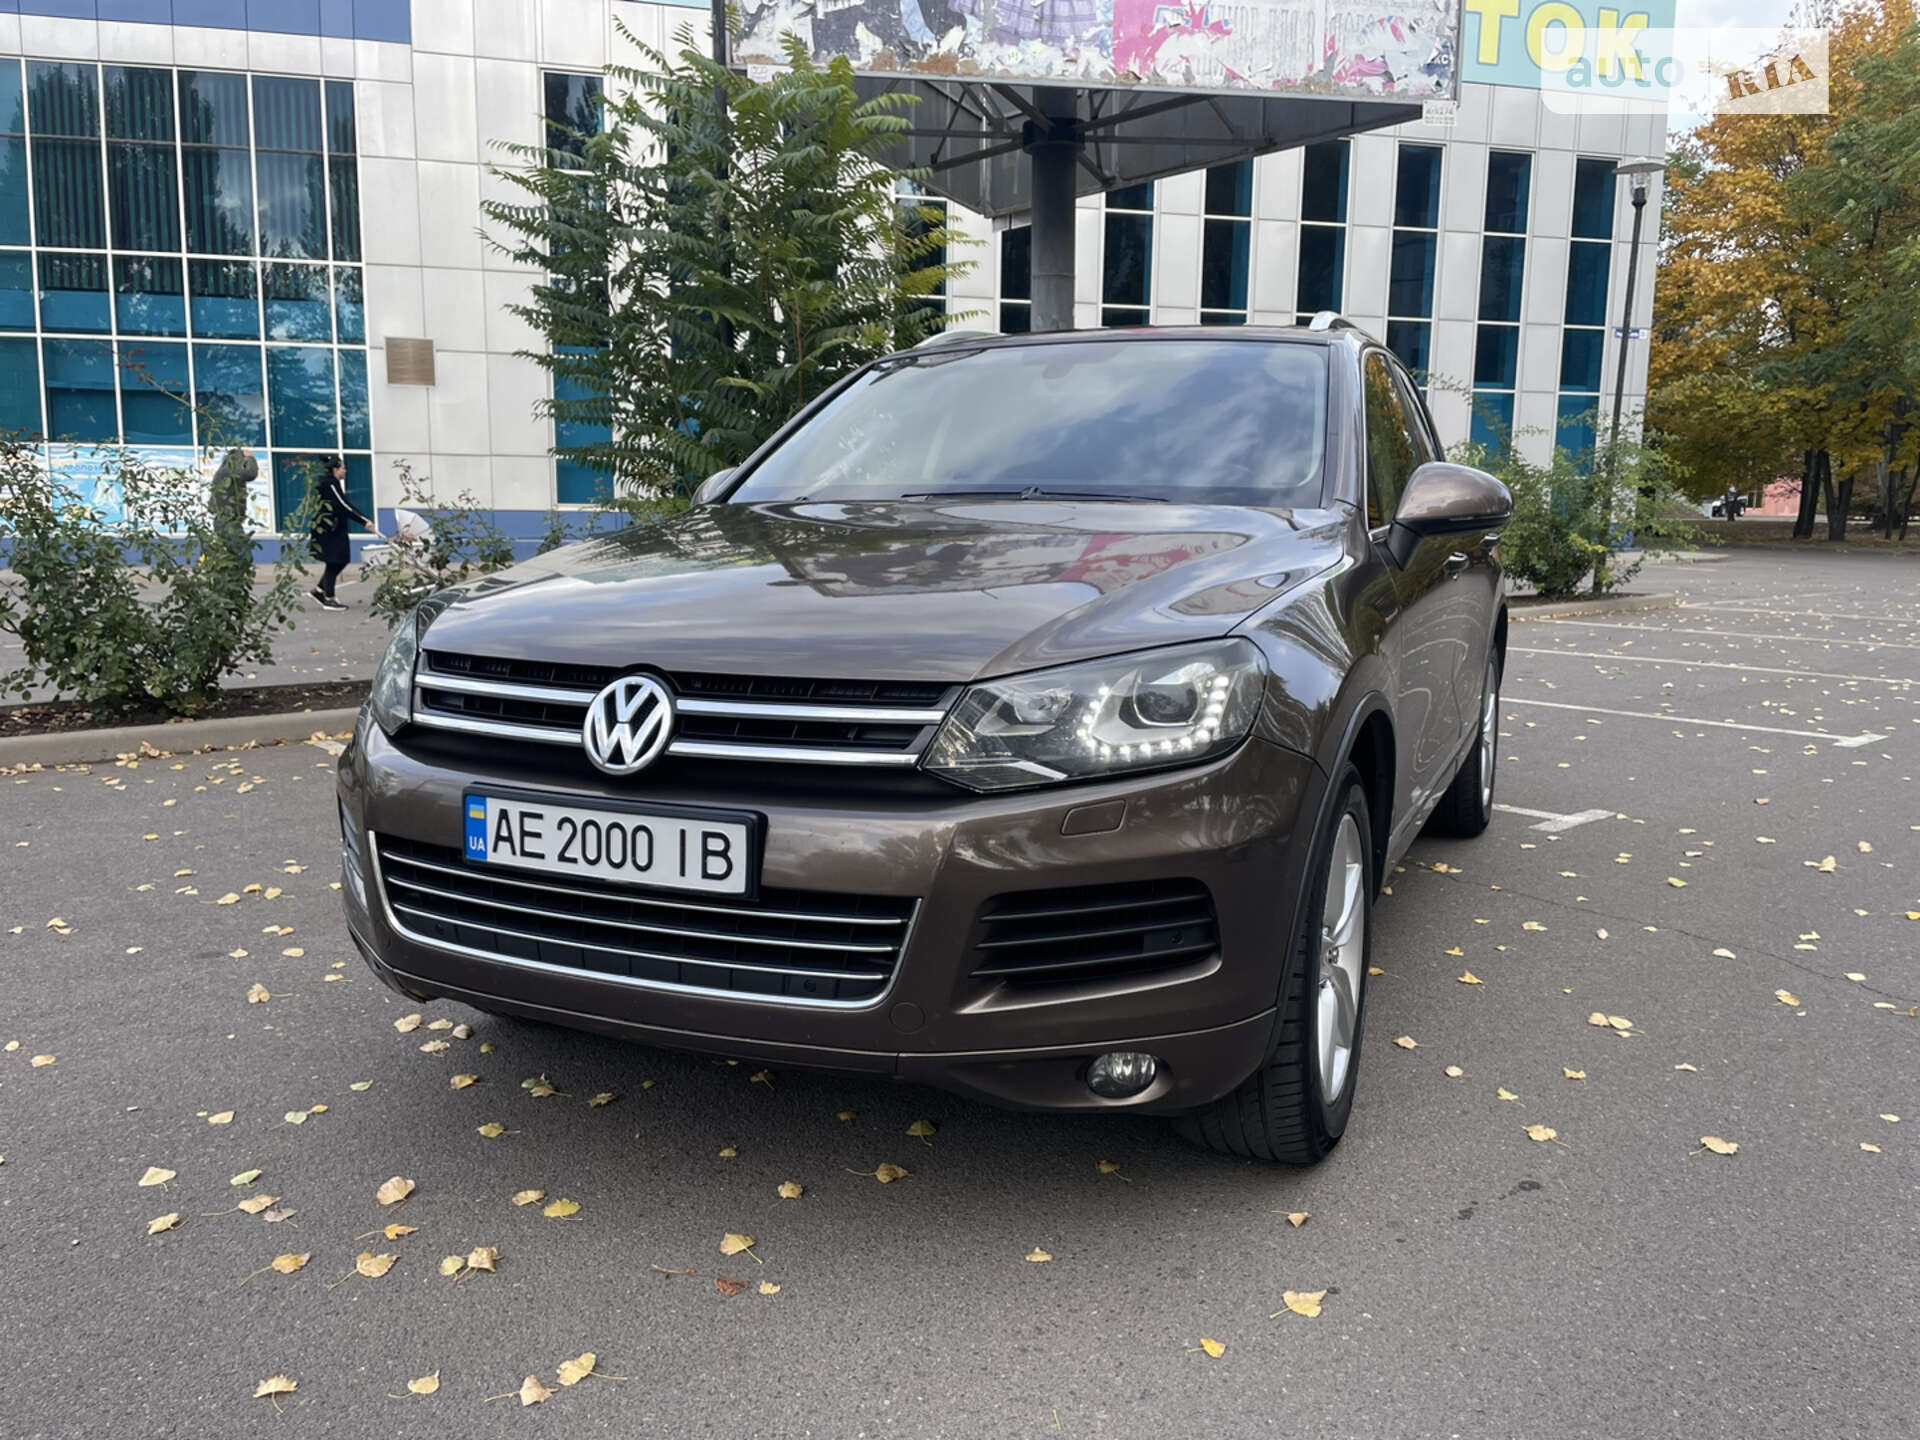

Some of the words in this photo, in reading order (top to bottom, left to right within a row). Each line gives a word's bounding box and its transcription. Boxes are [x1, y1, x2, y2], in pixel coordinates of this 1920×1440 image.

[469, 836, 486, 852] UA
[492, 808, 546, 860] AE
[556, 816, 654, 872] 2000
[679, 828, 734, 881] IB
